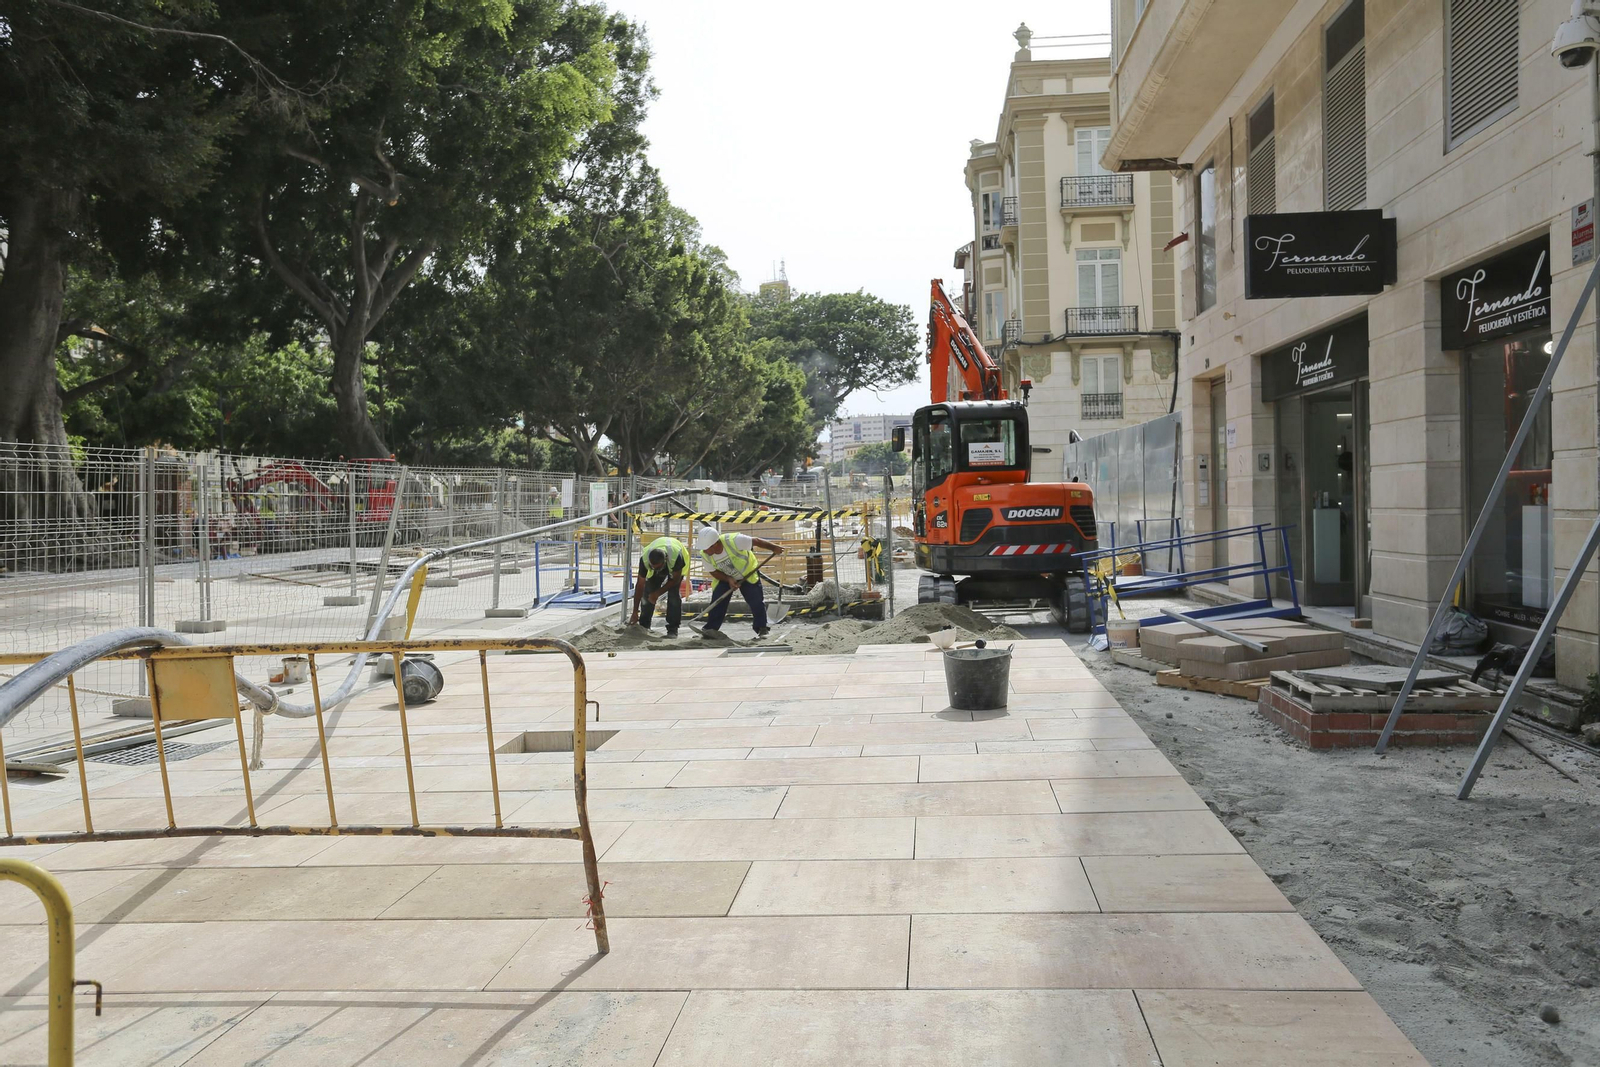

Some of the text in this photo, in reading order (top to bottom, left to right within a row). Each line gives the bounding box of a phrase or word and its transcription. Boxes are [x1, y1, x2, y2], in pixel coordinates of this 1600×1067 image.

[1255, 233, 1370, 272] Fernando
[1287, 264, 1330, 274] PELUQUERÍA
[1338, 264, 1370, 272] ESTÉTICA
[1456, 250, 1546, 333] Fernando
[1478, 305, 1547, 334] PELUQUERÍA Y ESTÉTICA
[950, 339, 968, 368] DOOSAN
[1292, 334, 1334, 385] Fernando
[1007, 508, 1060, 519] DOOSAN
[1495, 609, 1510, 618] HOMBRE
[1514, 613, 1526, 621] MUJER
